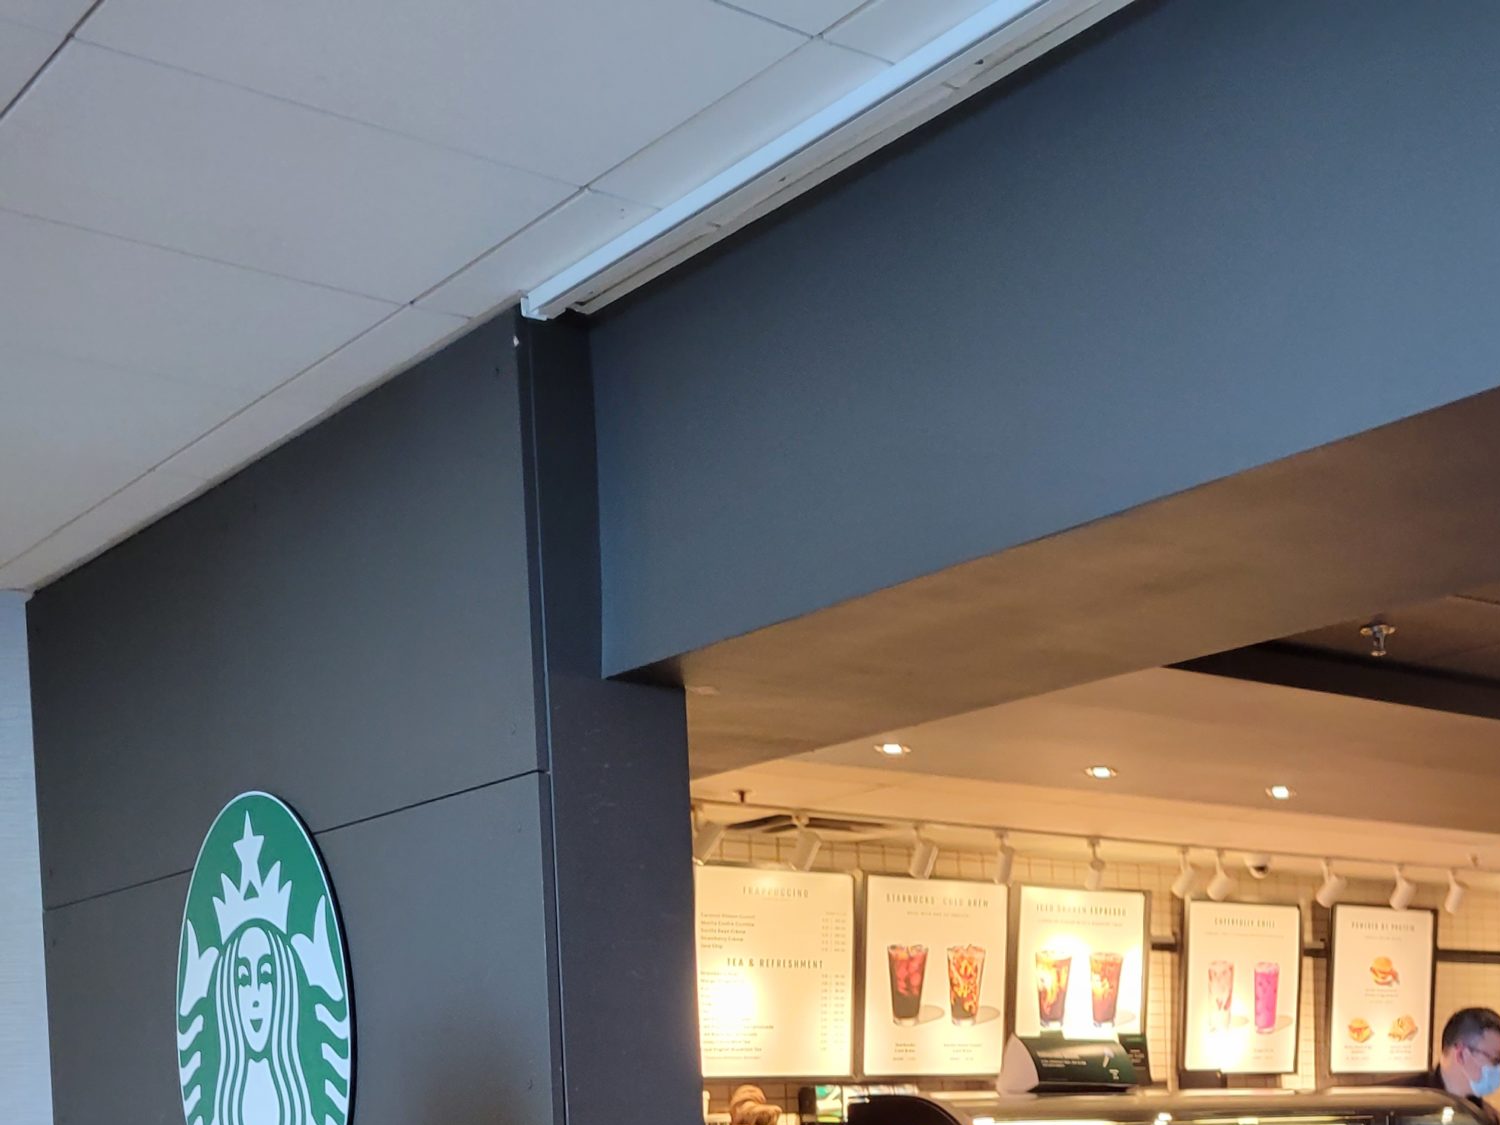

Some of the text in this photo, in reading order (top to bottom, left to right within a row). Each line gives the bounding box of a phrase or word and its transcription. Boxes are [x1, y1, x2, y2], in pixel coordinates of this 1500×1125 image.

[727, 957, 824, 969] TEA & REFRESHMENT
